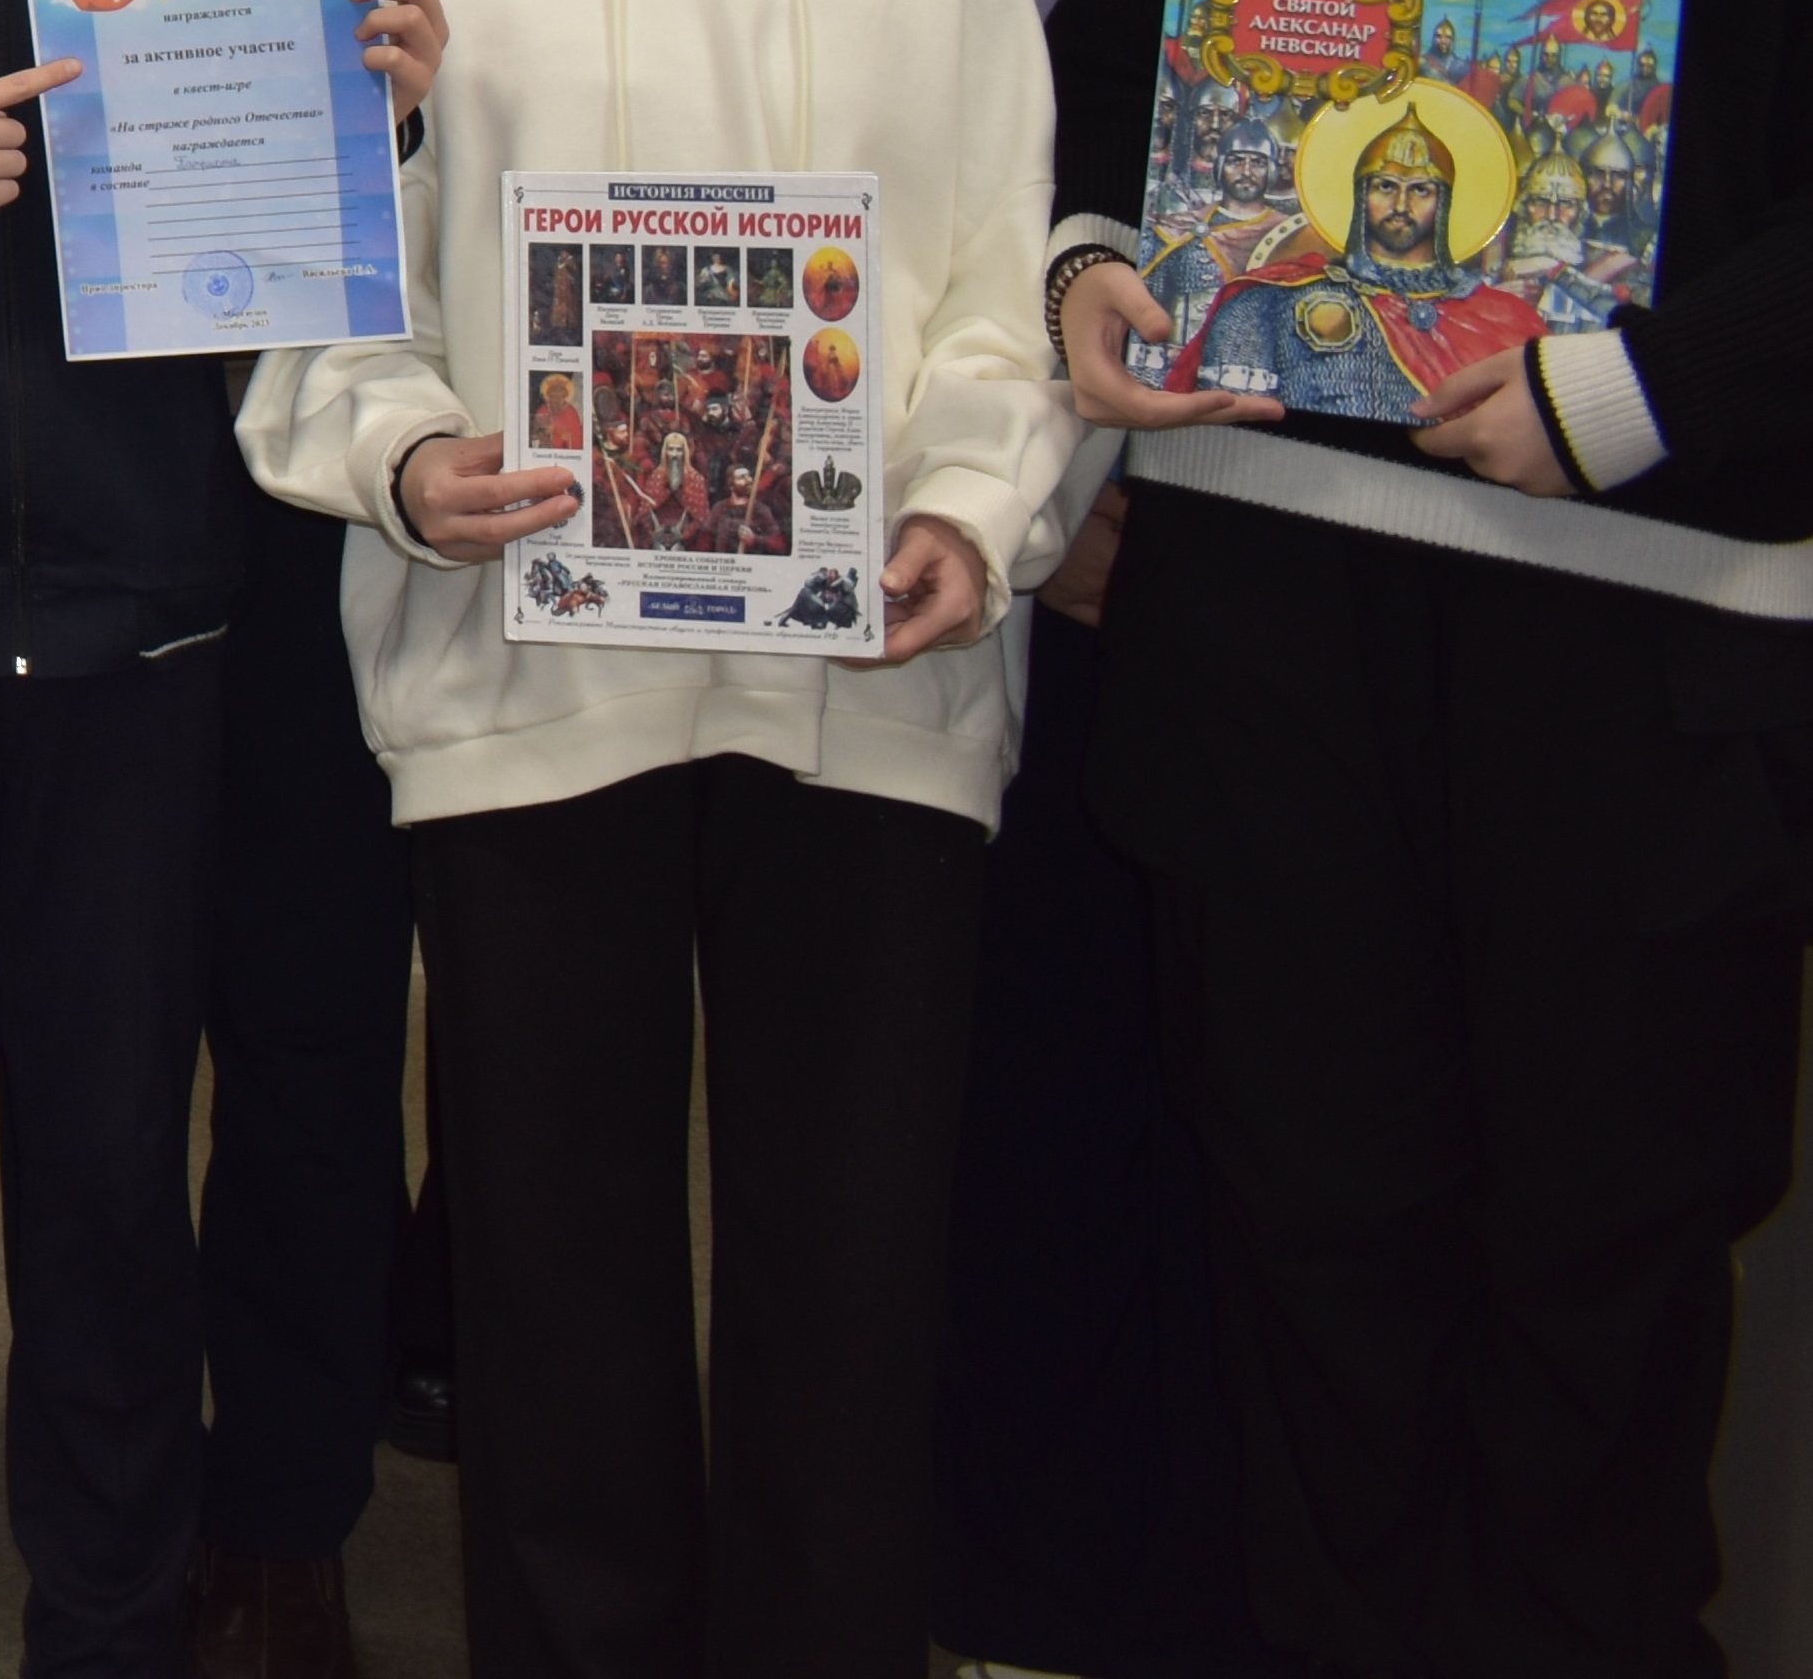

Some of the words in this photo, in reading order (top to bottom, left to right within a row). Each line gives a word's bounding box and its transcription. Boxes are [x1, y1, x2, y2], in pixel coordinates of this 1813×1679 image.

[163, 6, 252, 23] награждается
[1250, 15, 1377, 43] АЛЕКСАНДР
[122, 51, 139, 66] за
[144, 42, 223, 66] активное
[228, 37, 296, 61] участие
[1260, 35, 1361, 60] НЕВСКИЙ
[184, 80, 252, 95] квест-игре
[110, 122, 135, 134] «На
[138, 119, 189, 133] страже
[192, 114, 241, 129] родного
[245, 108, 324, 123] Отечества»
[172, 136, 265, 152] награждается
[91, 162, 142, 175] команда
[90, 184, 97, 192] в
[100, 180, 150, 191] составе
[613, 185, 697, 200] ИСТОРИЯ
[700, 186, 770, 201] РОССИИ
[523, 209, 603, 233] ГЕРОИ
[613, 206, 729, 236] РУССКОЙ
[738, 212, 862, 239] ИСТОРИИ
